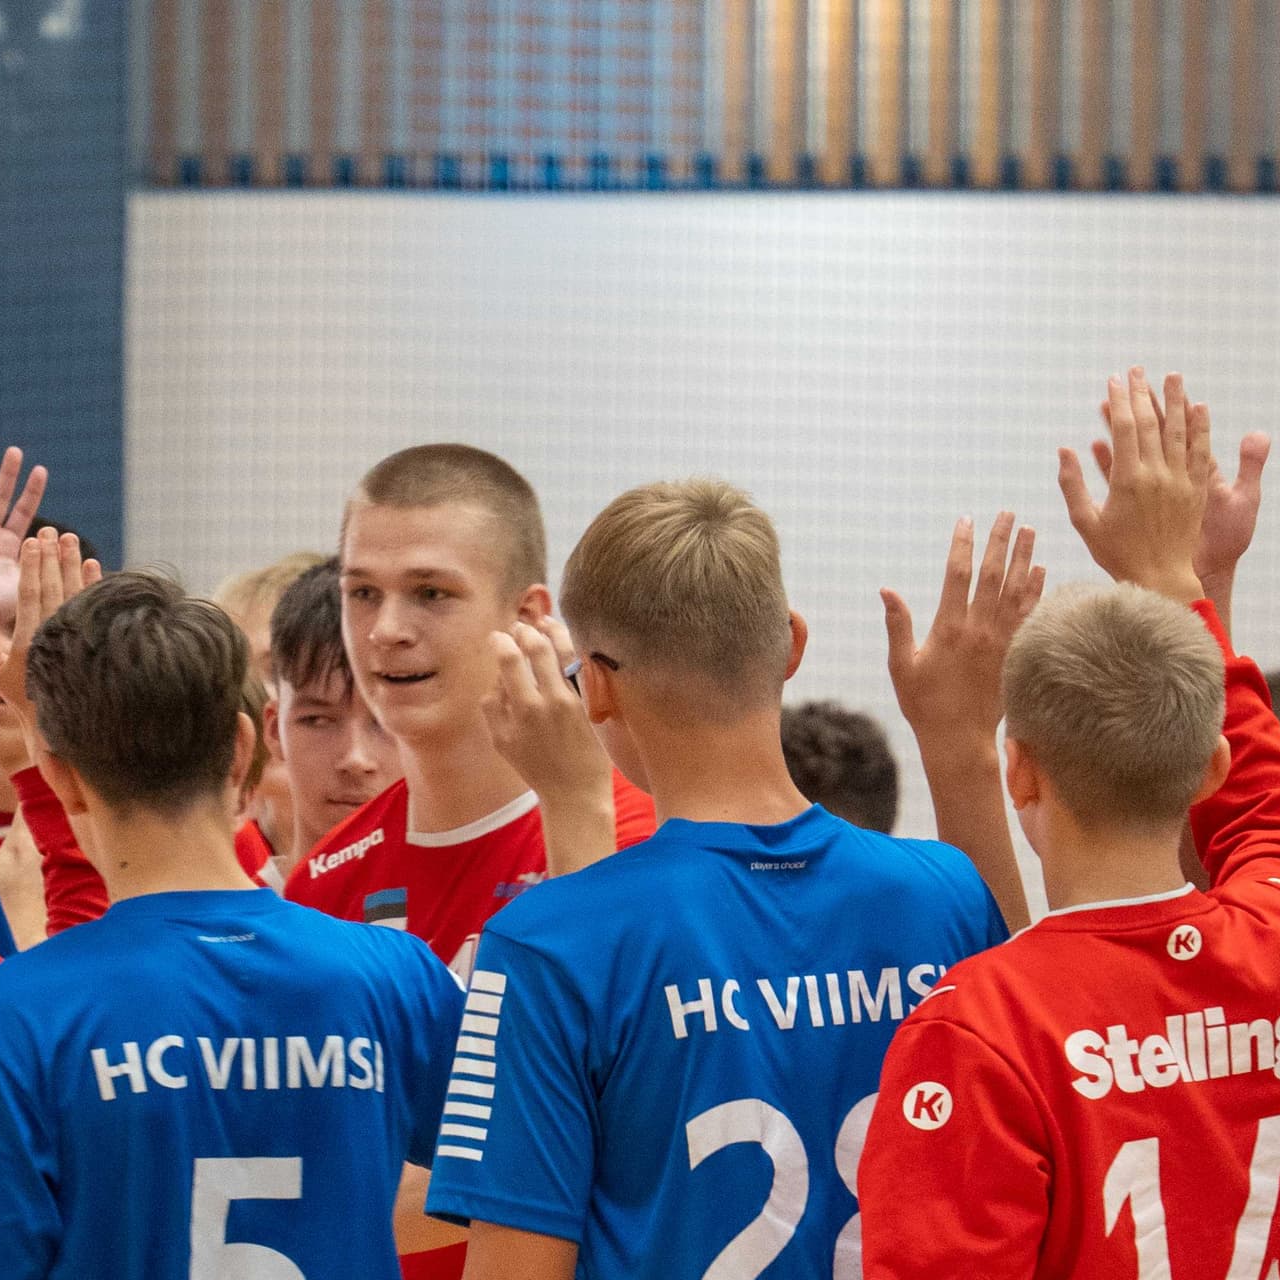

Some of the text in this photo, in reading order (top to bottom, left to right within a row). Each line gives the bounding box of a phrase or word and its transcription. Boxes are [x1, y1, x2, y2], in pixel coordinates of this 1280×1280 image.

[308, 828, 385, 879] Kempa
[756, 963, 949, 1030] VIIMS
[91, 1035, 384, 1101] HC VIIMSI
